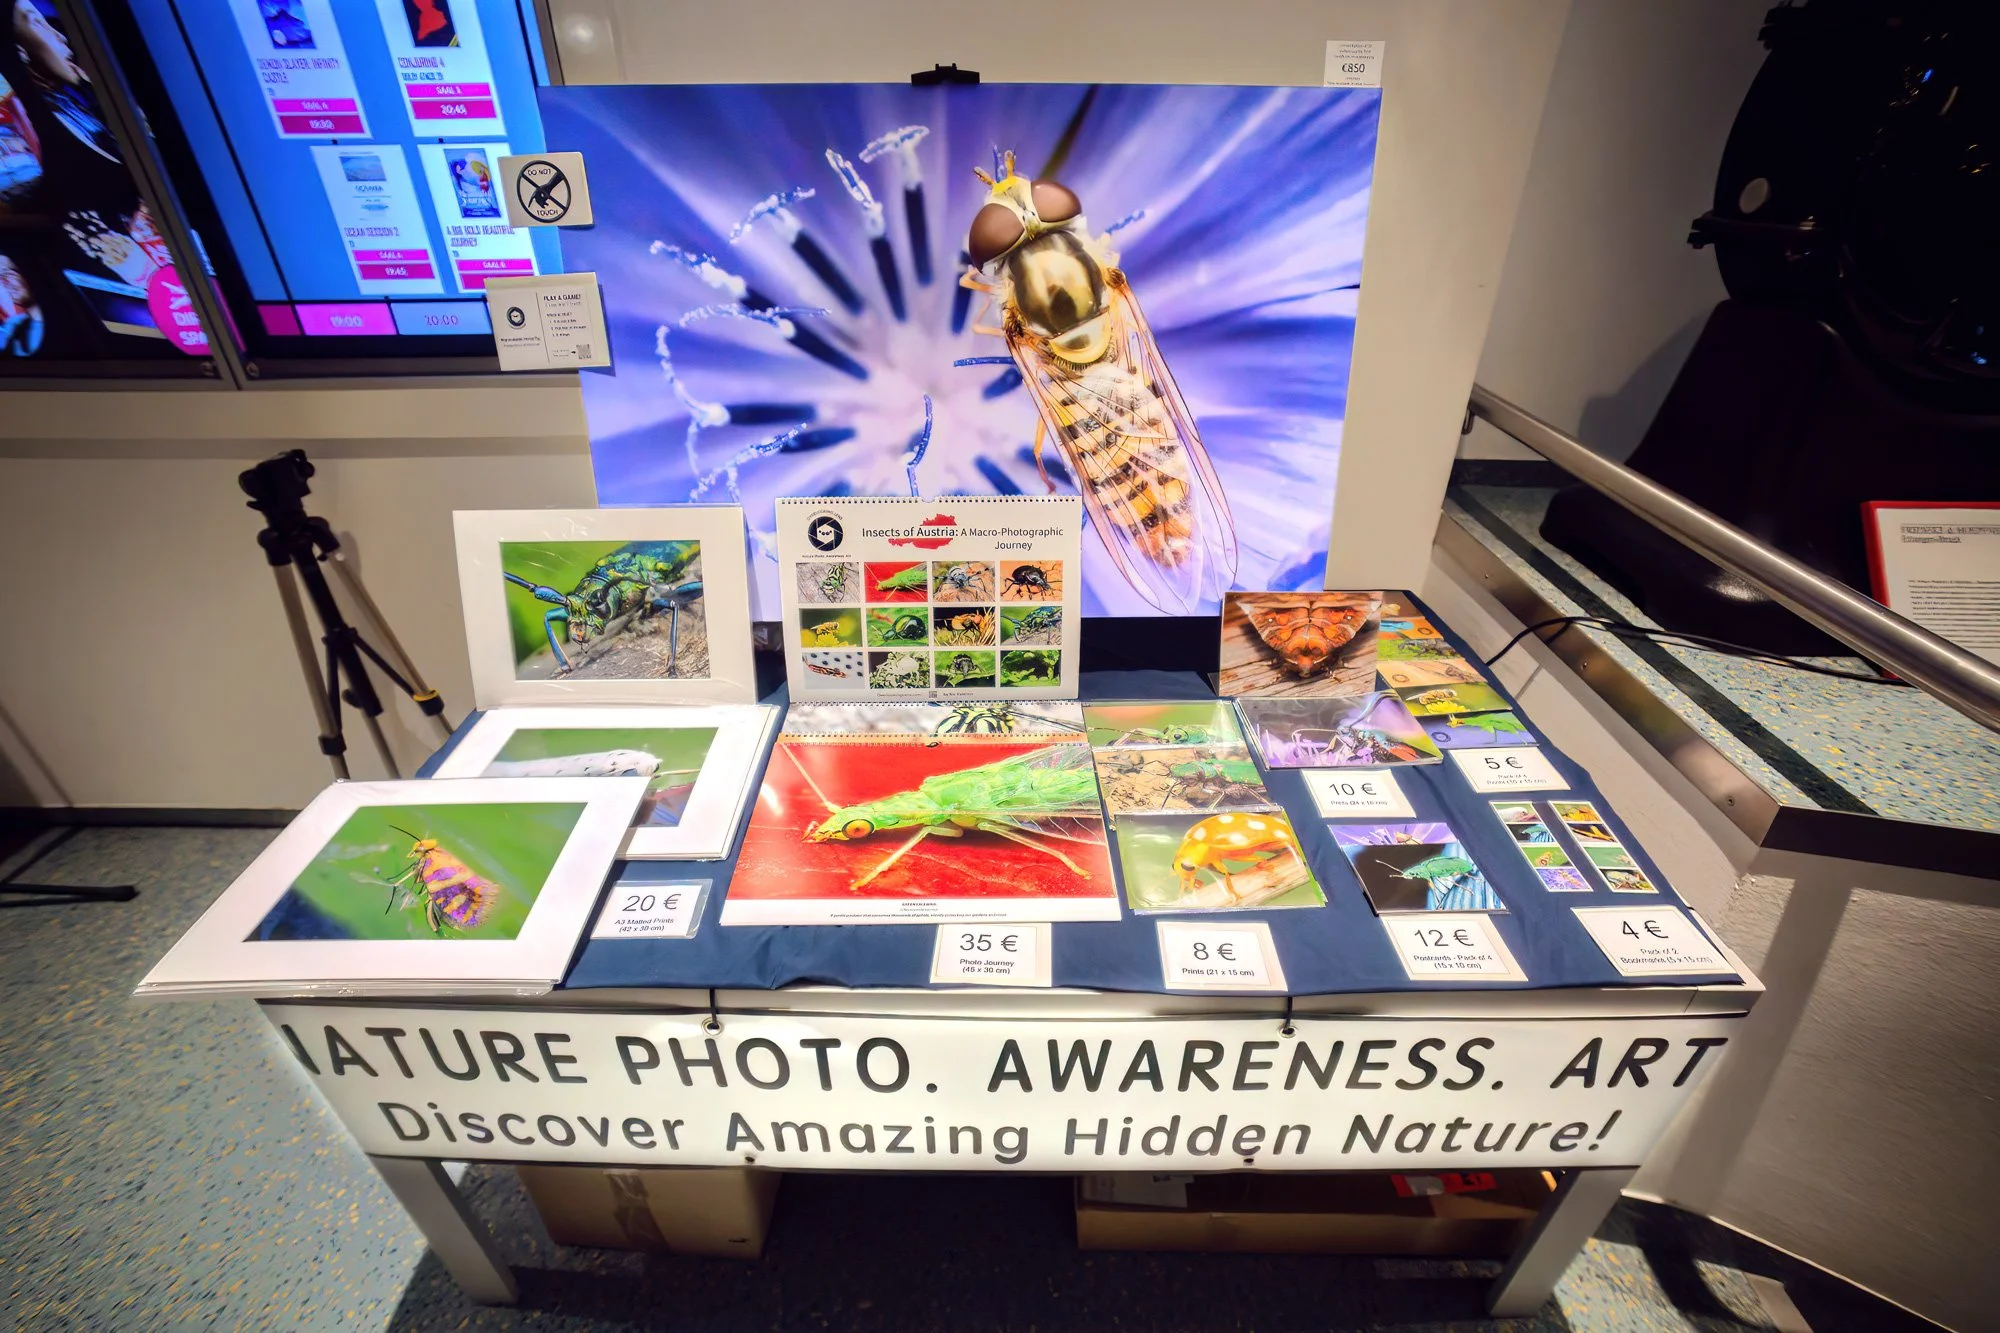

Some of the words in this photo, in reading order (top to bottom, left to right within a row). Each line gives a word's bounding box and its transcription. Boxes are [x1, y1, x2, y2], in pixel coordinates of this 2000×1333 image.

[1342, 63, 1365, 73] €850
[424, 314, 459, 326] 20:00
[862, 527, 901, 537] Insects
[903, 526, 914, 537] of
[916, 527, 959, 537] Austria:
[960, 528, 968, 537] A
[969, 527, 1064, 538] Macro-Photographic
[995, 540, 1033, 551] Journey
[1484, 757, 1500, 769] 5
[1505, 756, 1523, 768] €
[1329, 783, 1355, 795] 10
[1361, 782, 1377, 795] €
[622, 895, 655, 912] 20
[663, 893, 682, 910] €
[1623, 921, 1640, 939] 4
[1644, 920, 1669, 939] €
[959, 933, 992, 952] 35
[1000, 935, 1019, 953] €
[1414, 929, 1449, 947] 12
[1453, 929, 1474, 947] €
[1193, 942, 1209, 961] 8
[1217, 943, 1236, 961] €
[959, 958, 982, 966] Photo
[983, 959, 1015, 968] Journey
[962, 966, 975, 974] (45
[995, 967, 1010, 975] cm)
[1206, 968, 1218, 976] (21
[1239, 969, 1255, 977] cm)
[615, 1036, 938, 1093] PHOTO.
[986, 1037, 1505, 1094] AWARENESS.
[1550, 1037, 1729, 1088] ART
[378, 1101, 685, 1151] Discover
[726, 1112, 1030, 1164] Amazing
[1064, 1113, 1311, 1157] Hidden
[1340, 1110, 1622, 1154] Nature!
